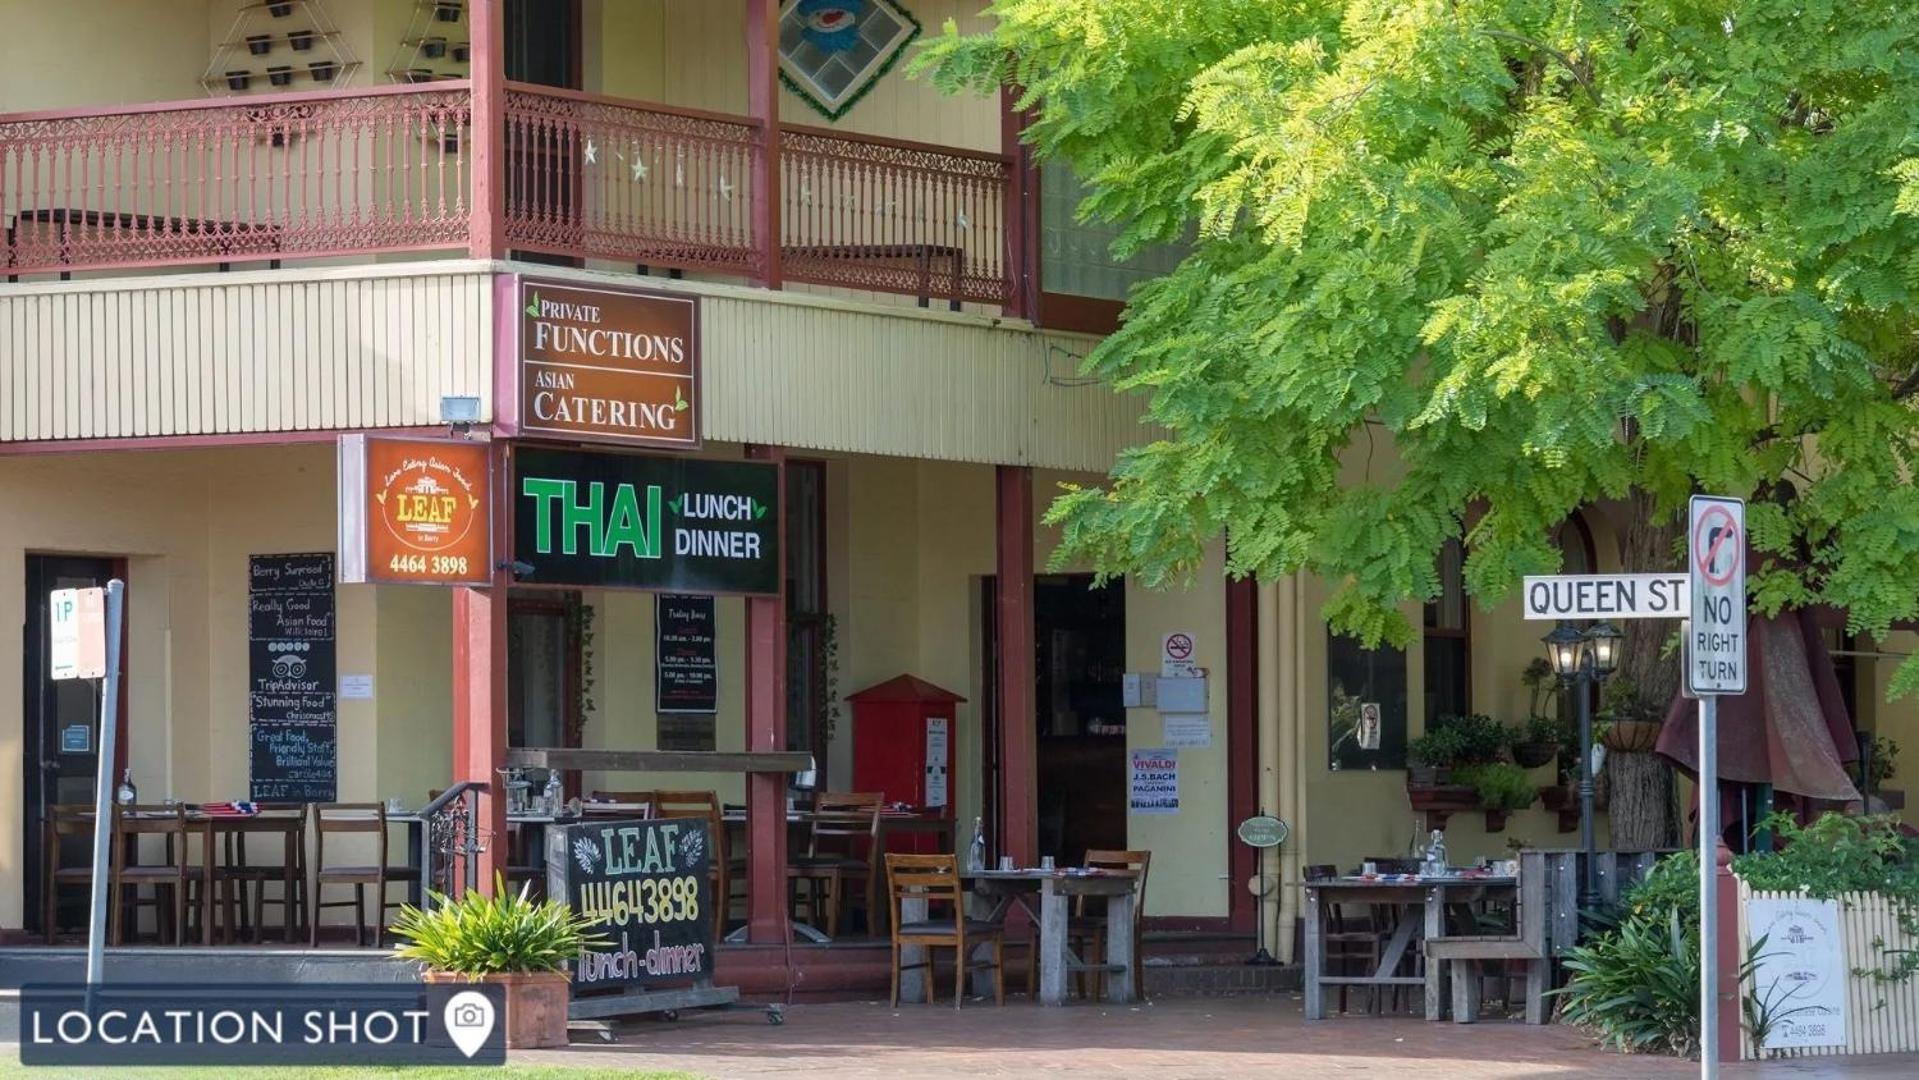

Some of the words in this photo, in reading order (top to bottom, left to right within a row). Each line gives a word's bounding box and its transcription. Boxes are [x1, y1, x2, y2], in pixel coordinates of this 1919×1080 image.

[541, 299, 601, 323] PRIVATE
[535, 321, 684, 363] FUNCTIONS
[535, 370, 575, 390] ASIAN
[534, 391, 676, 430] CATERING
[396, 493, 456, 523] LEAF
[683, 492, 752, 520] LUNCH
[523, 477, 662, 559] THAI
[675, 528, 761, 559] DINNER
[253, 564, 280, 580] Berry
[390, 554, 427, 573] 4464
[431, 555, 468, 575] 3898
[286, 598, 311, 611] Good
[1530, 580, 1636, 614] QUEEN
[1648, 579, 1685, 611] ST
[276, 614, 304, 627] Asian
[1704, 596, 1732, 625] NO
[1697, 632, 1739, 653] RIGHT
[1699, 661, 1738, 680] TURN
[257, 678, 320, 694] TripAdvisor
[1133, 760, 1176, 769] VIVALDI
[253, 784, 289, 798] LEAF
[1133, 785, 1176, 793] PAGANINI
[601, 824, 679, 876] LEAF
[580, 875, 699, 926] 44643898
